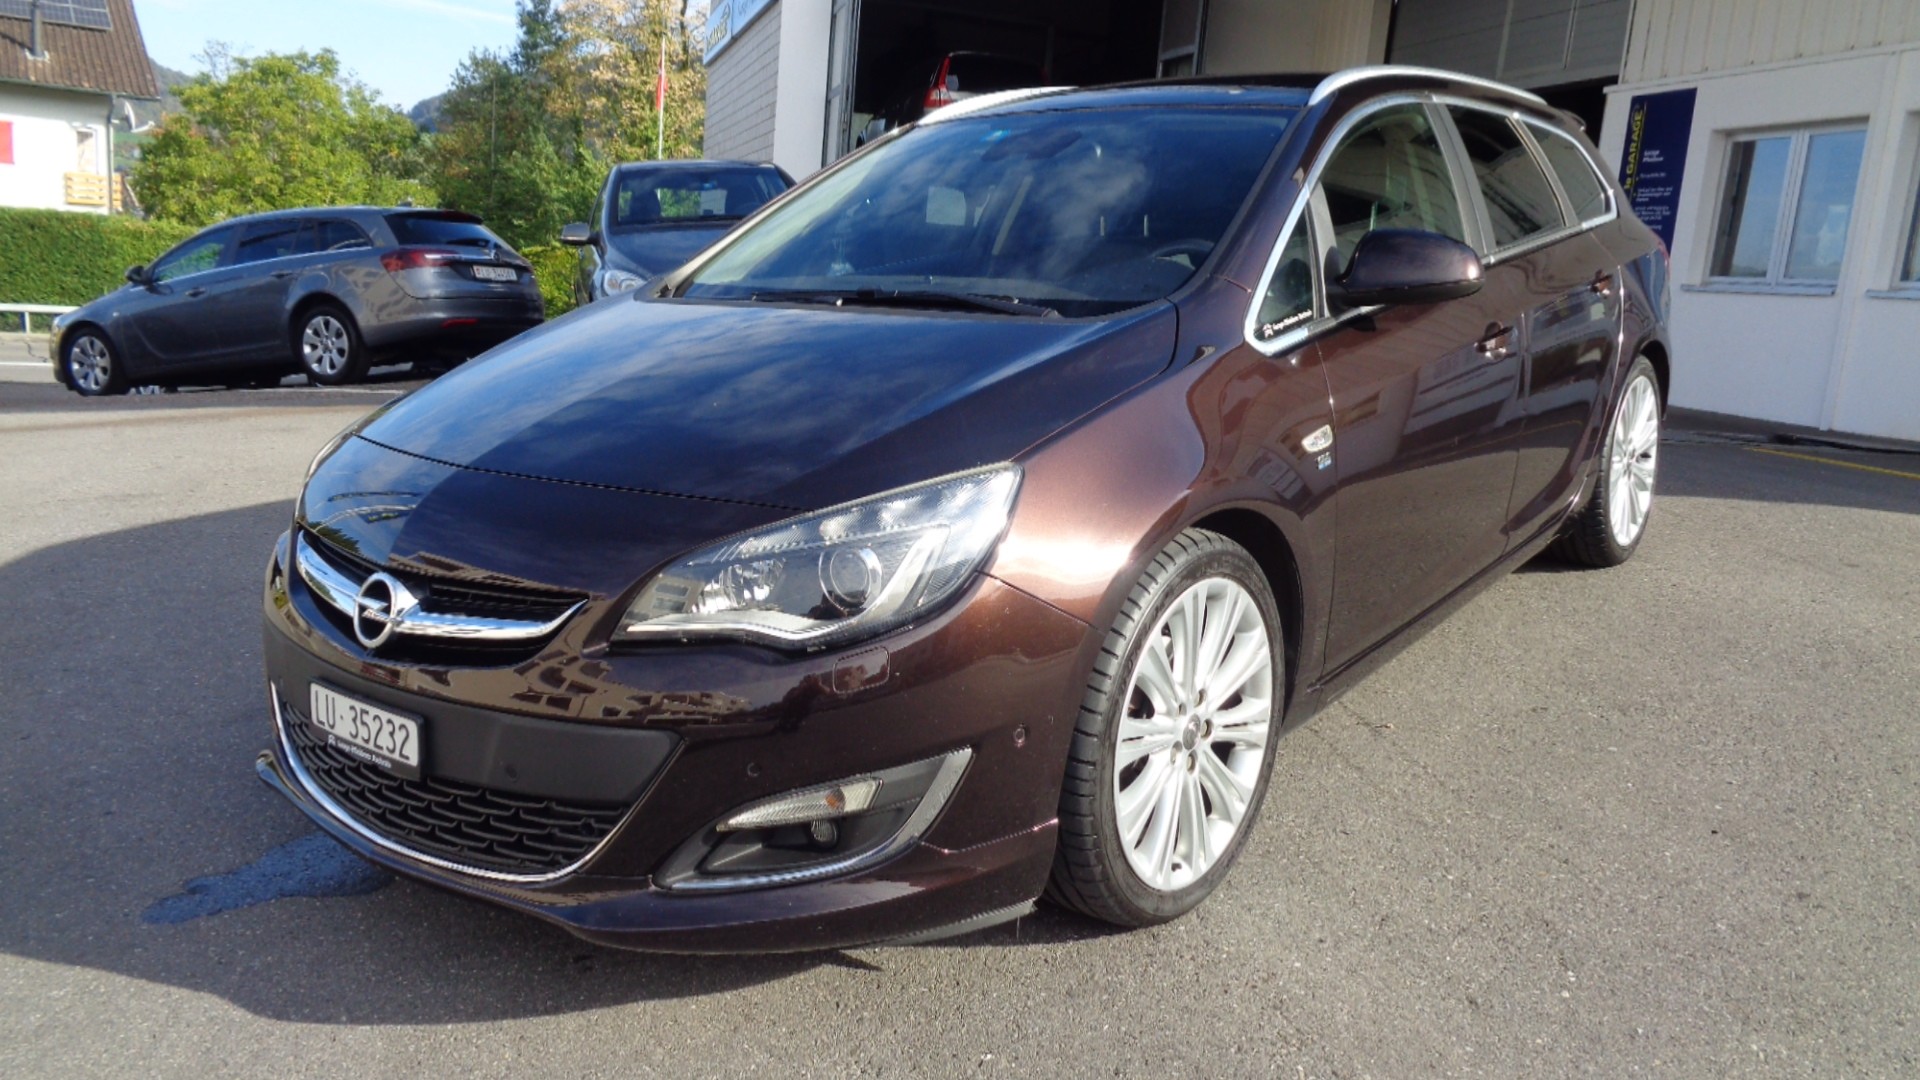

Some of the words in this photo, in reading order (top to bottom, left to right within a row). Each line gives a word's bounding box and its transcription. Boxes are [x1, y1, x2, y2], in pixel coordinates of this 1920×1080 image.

[1626, 108, 1643, 174] GARAGE
[316, 690, 336, 729] LU
[349, 705, 411, 761] 35232
